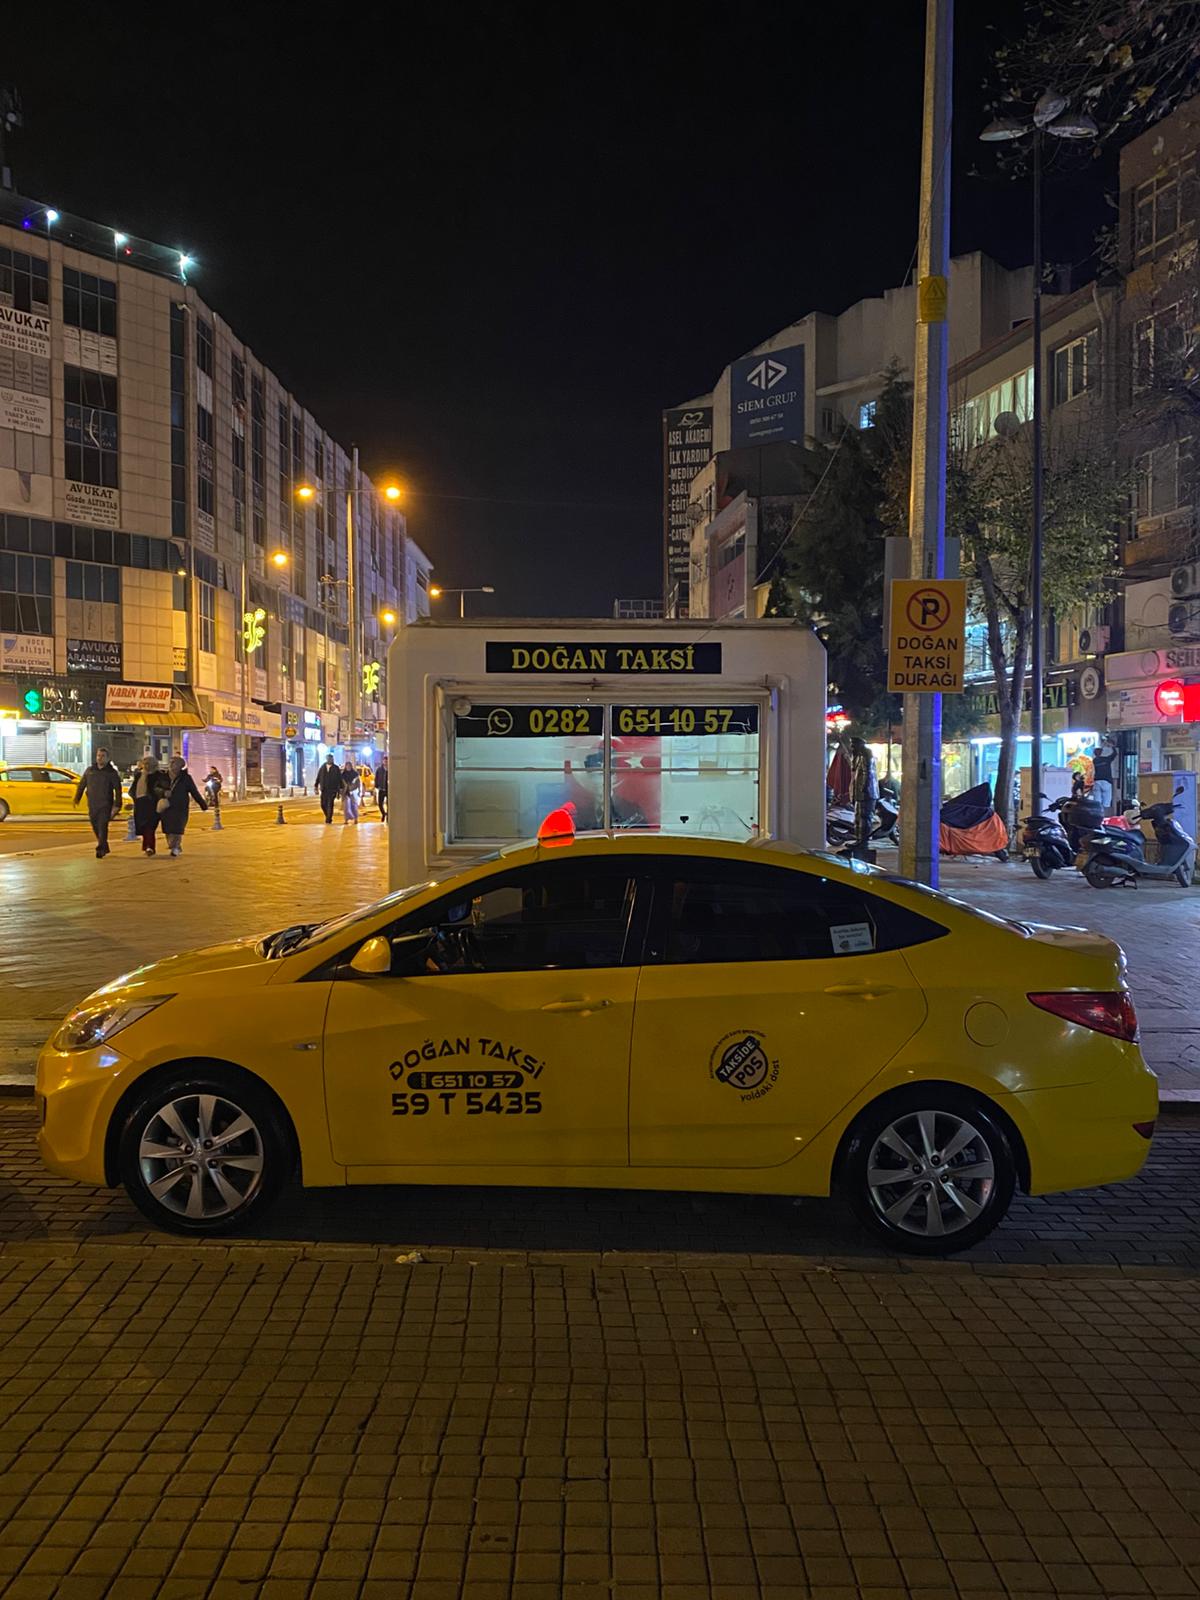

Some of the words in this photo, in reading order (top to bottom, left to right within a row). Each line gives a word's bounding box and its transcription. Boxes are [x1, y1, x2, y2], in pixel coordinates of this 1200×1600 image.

[766, 391, 797, 407] GRUP
[668, 431, 683, 446] ASEL
[669, 447, 681, 465] İLK
[682, 448, 710, 464] YARDIM
[69, 483, 114, 499] AVUKAT
[81, 641, 120, 654] AVUKAT
[897, 635, 958, 653] DOĞAN
[67, 652, 121, 665] ARABULUCU
[512, 646, 607, 669] DOĞAN
[617, 645, 695, 669] TAKSİ
[904, 655, 951, 669] TAKSİ
[894, 672, 957, 688] DURAĞI
[108, 687, 137, 698] NARİN
[139, 689, 170, 701] KASAP
[529, 708, 590, 733] 0282
[619, 708, 661, 732] 651
[669, 708, 695, 732] 10
[704, 708, 733, 732] 57
[389, 1037, 470, 1081] DOĞAN
[478, 1038, 546, 1080] TAKSİ
[719, 1040, 756, 1077] TAKSİDE
[734, 1056, 763, 1085] POS
[771, 1059, 780, 1082] dost
[431, 1075, 463, 1088] 651
[468, 1075, 487, 1087] 10
[492, 1075, 517, 1087] 57
[740, 1080, 774, 1102] yoldaki
[391, 1093, 430, 1116] 59
[439, 1093, 457, 1116] T
[466, 1092, 543, 1115] 5435
